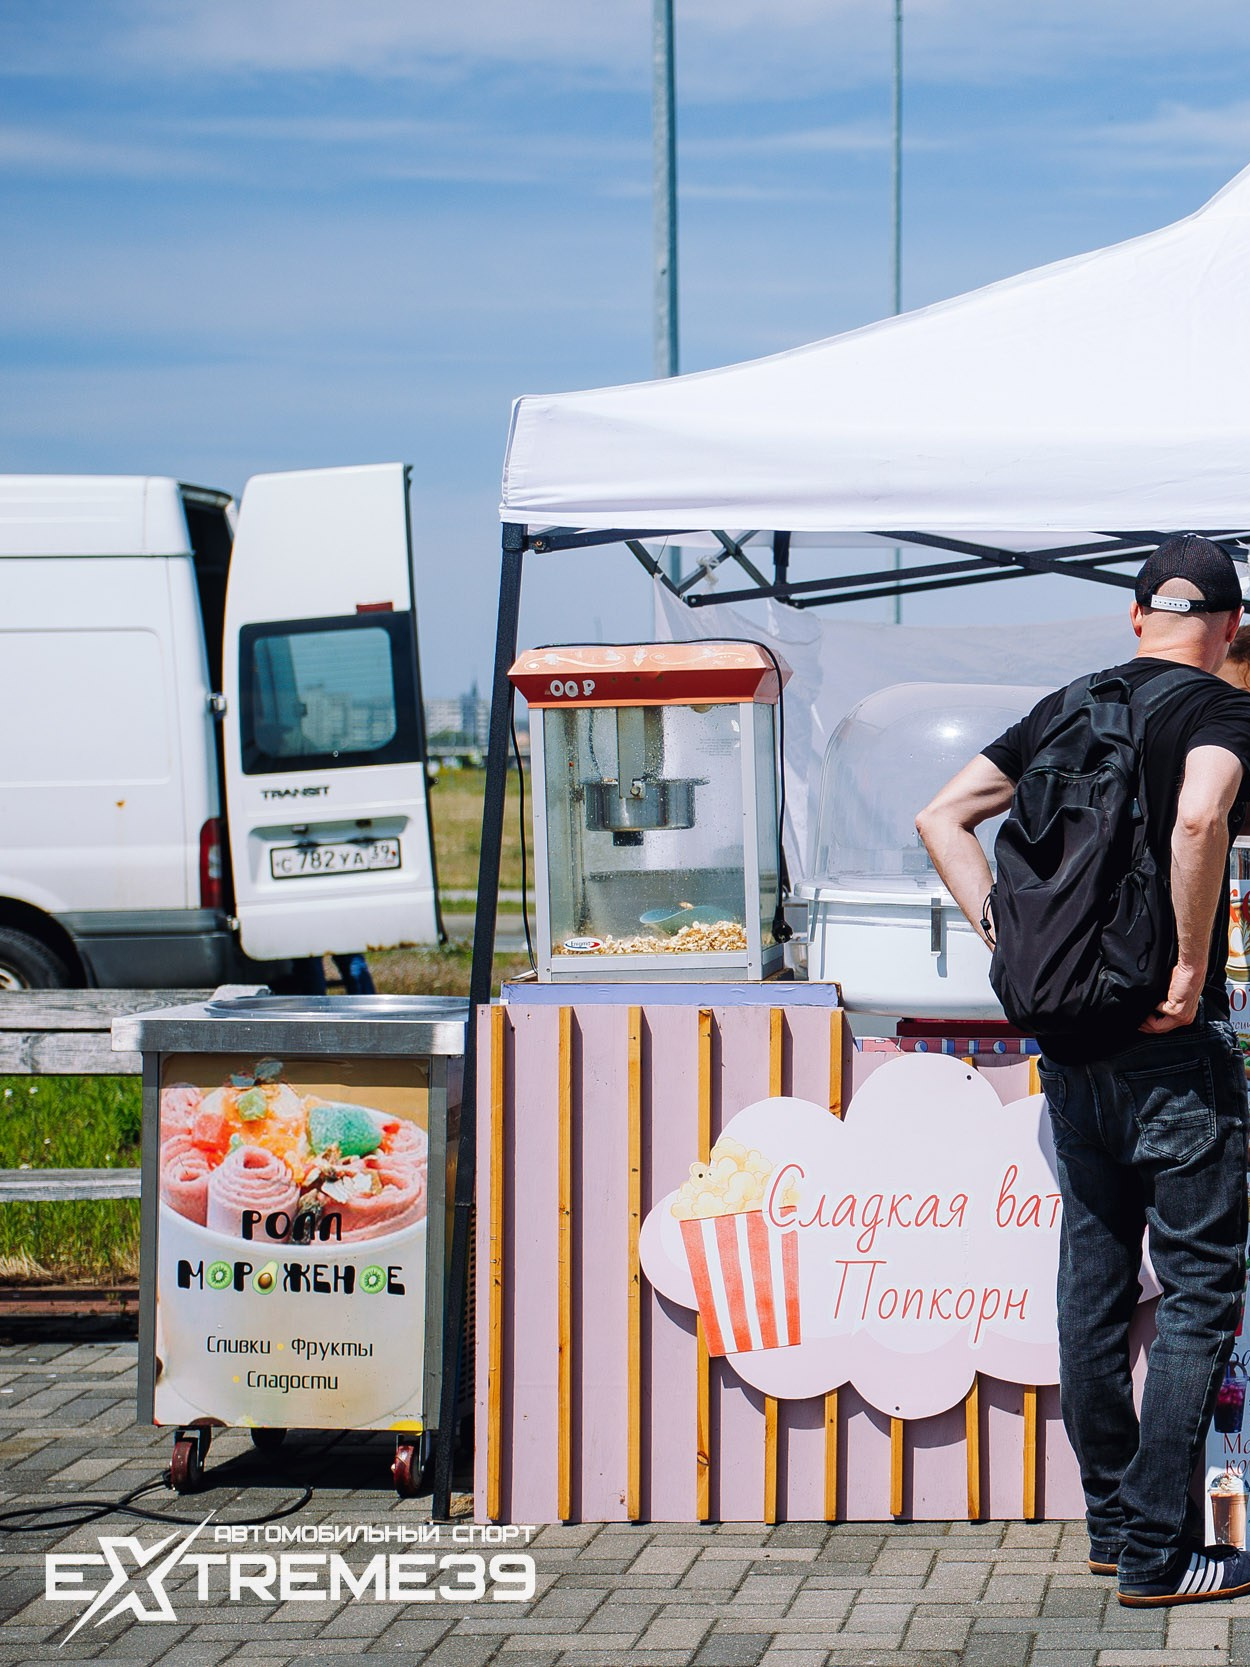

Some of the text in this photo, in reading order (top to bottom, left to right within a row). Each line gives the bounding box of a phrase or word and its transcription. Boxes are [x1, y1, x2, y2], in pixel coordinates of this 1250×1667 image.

[261, 786, 330, 801] TRANSIT
[767, 1163, 1062, 1253] Сладкая ват
[242, 1209, 343, 1241] РОЛЛ
[833, 1259, 1030, 1344] Попкорн
[206, 1335, 374, 1361] Сливки Фрукты
[246, 1371, 339, 1394] Сладости
